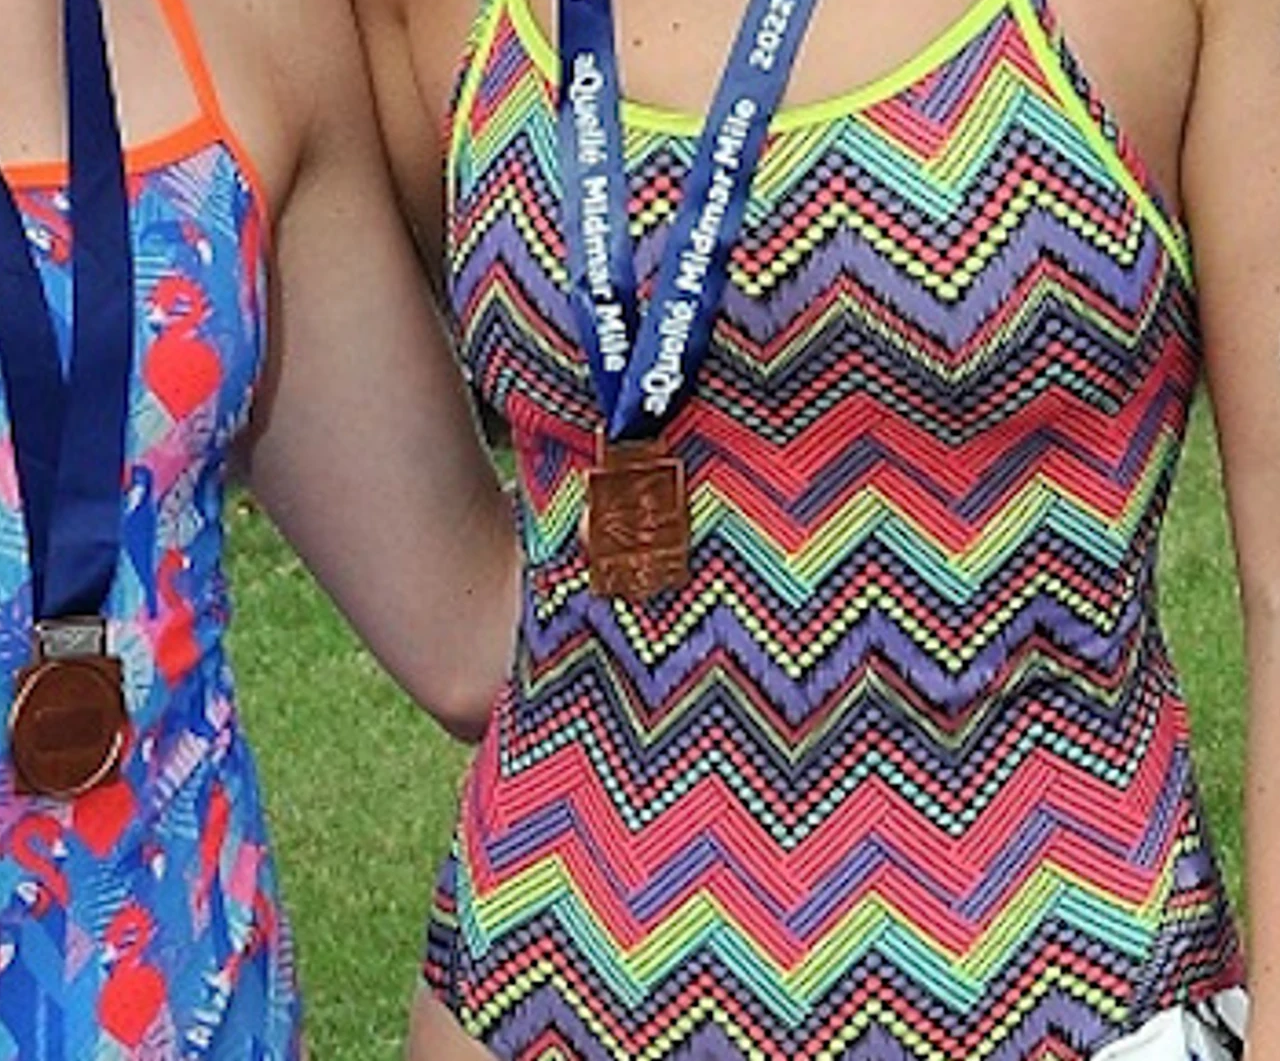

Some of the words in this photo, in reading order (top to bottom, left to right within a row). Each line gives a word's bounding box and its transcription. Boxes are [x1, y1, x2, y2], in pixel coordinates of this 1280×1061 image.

[581, 176, 612, 301] Midmar
[675, 168, 734, 294] Midmar
[713, 98, 757, 169] Mile
[595, 303, 629, 372] Mile
